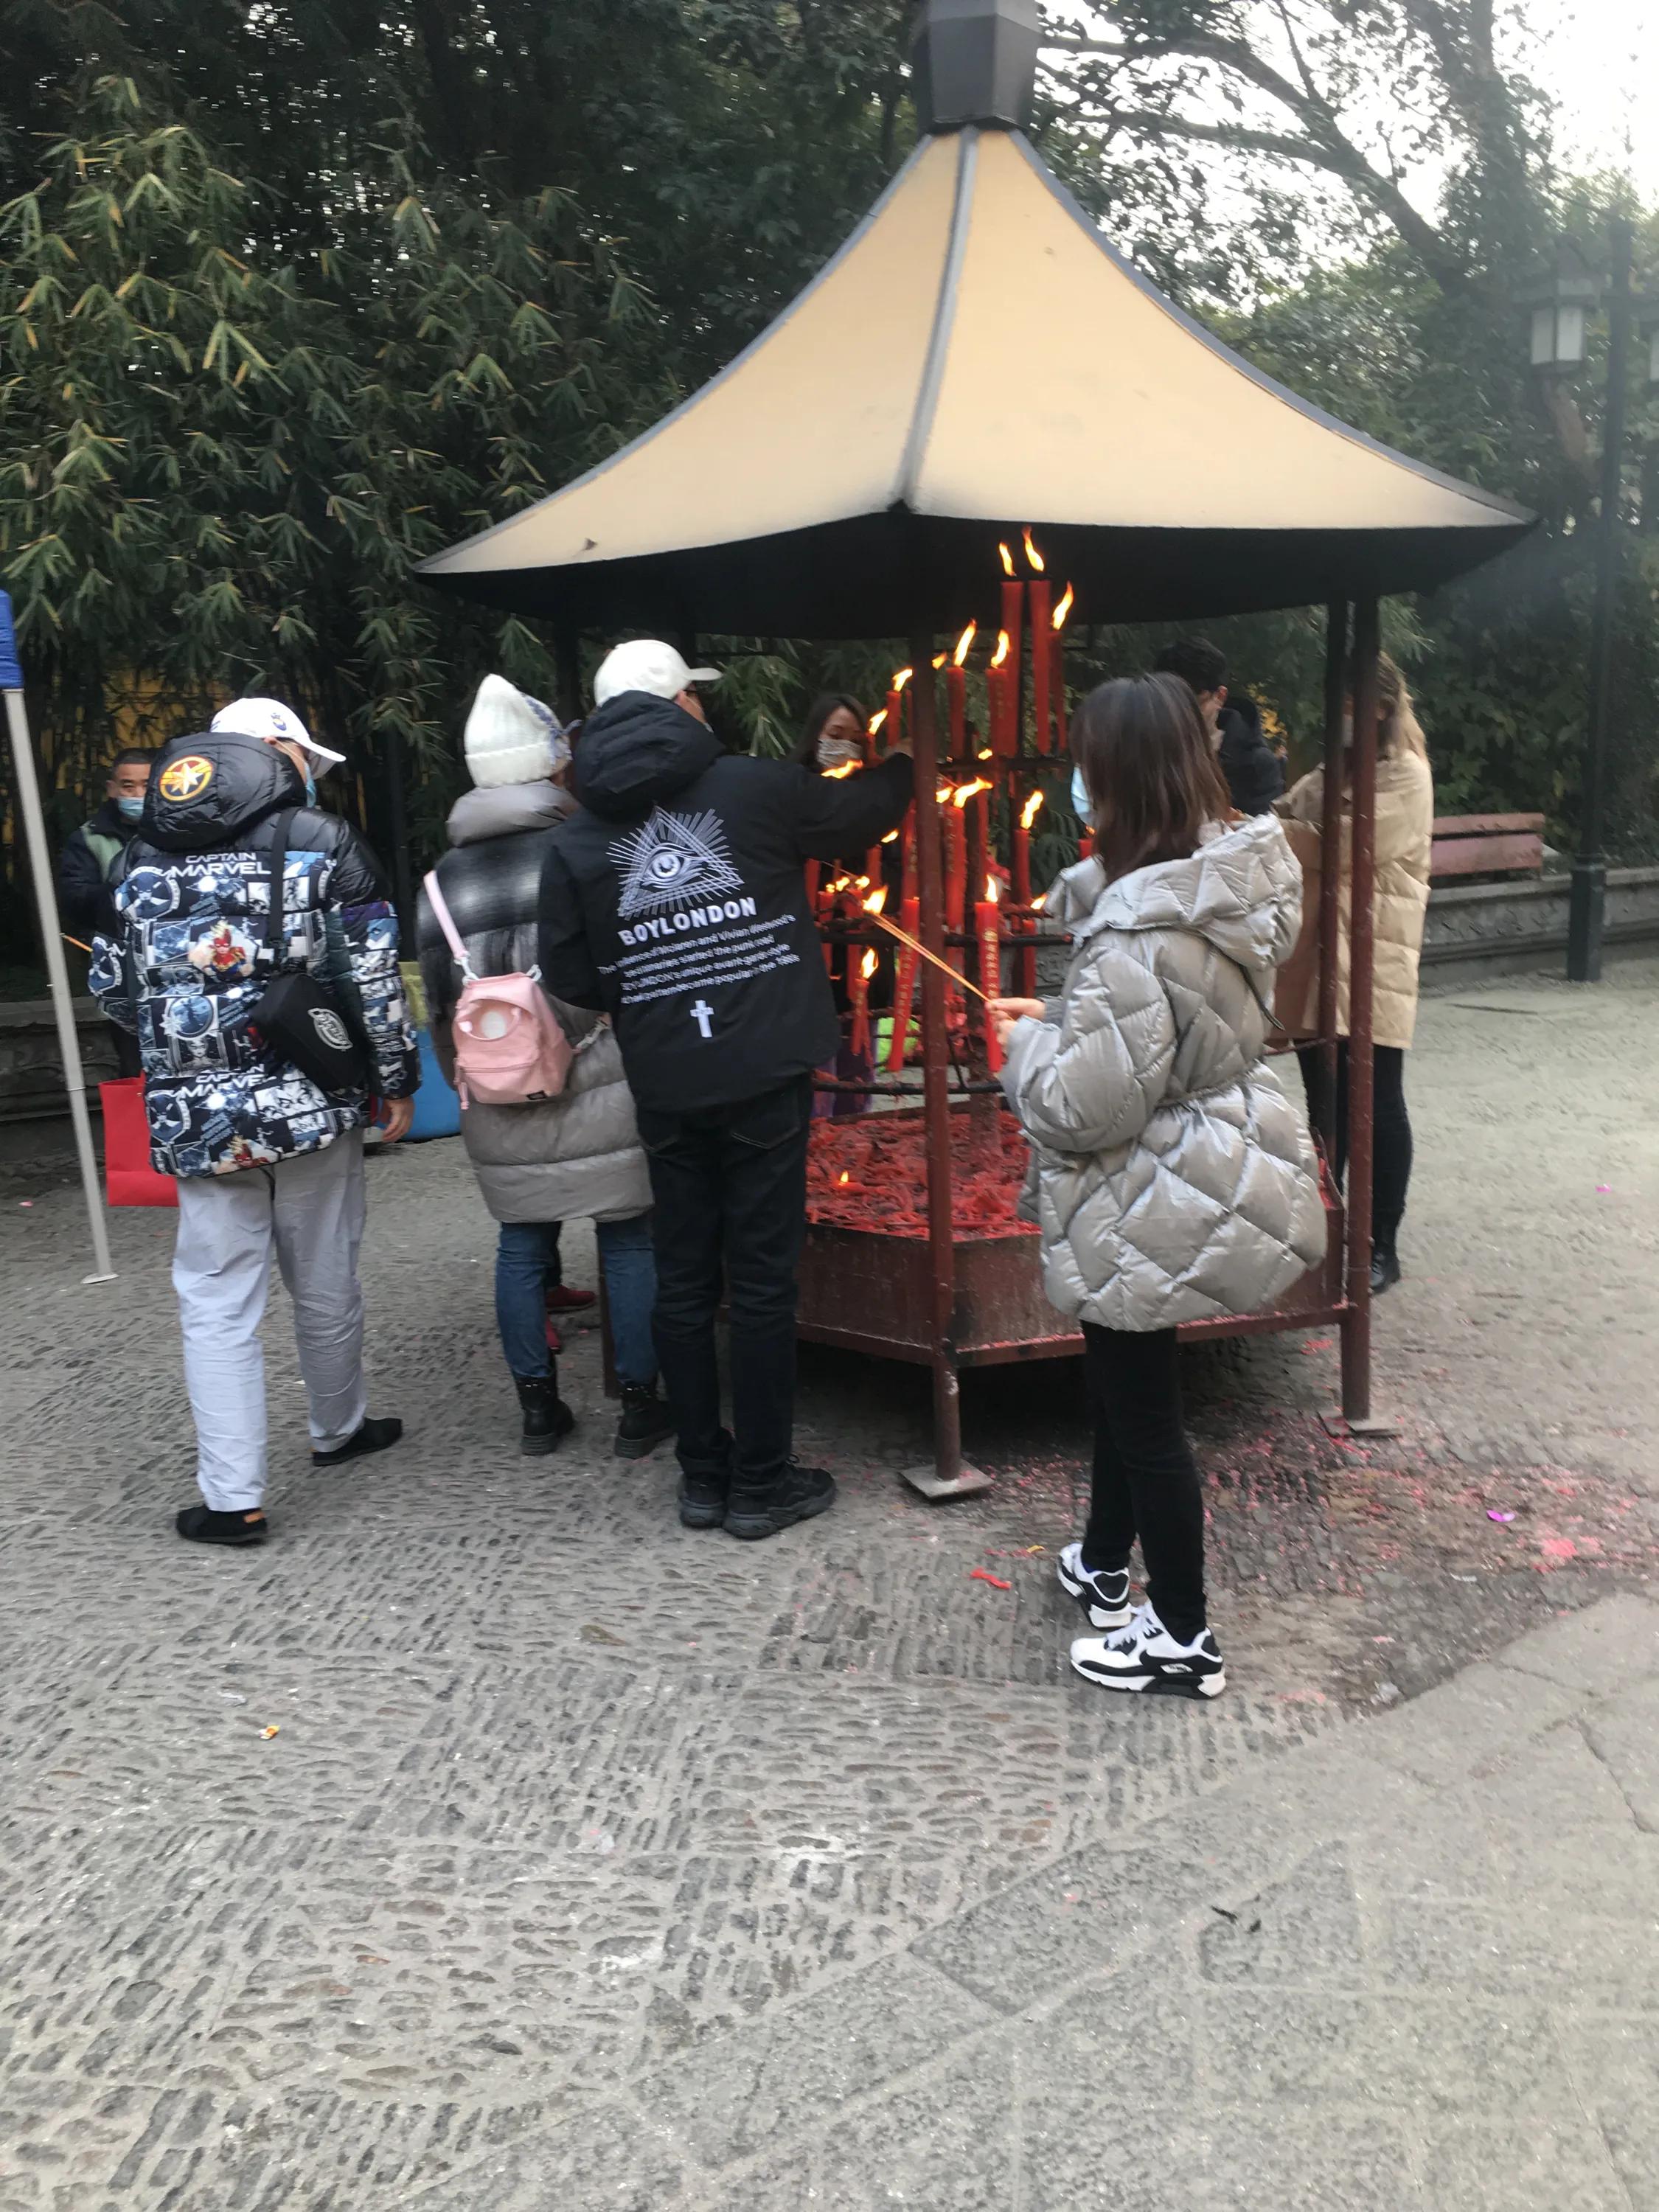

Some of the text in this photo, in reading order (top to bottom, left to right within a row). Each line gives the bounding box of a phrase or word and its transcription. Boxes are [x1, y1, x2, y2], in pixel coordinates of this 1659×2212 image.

[185, 852, 256, 863] CAPTAIN
[170, 861, 272, 877] MARVEL
[618, 897, 757, 946] BOYLONDON
[195, 1064, 265, 1083] CAPN
